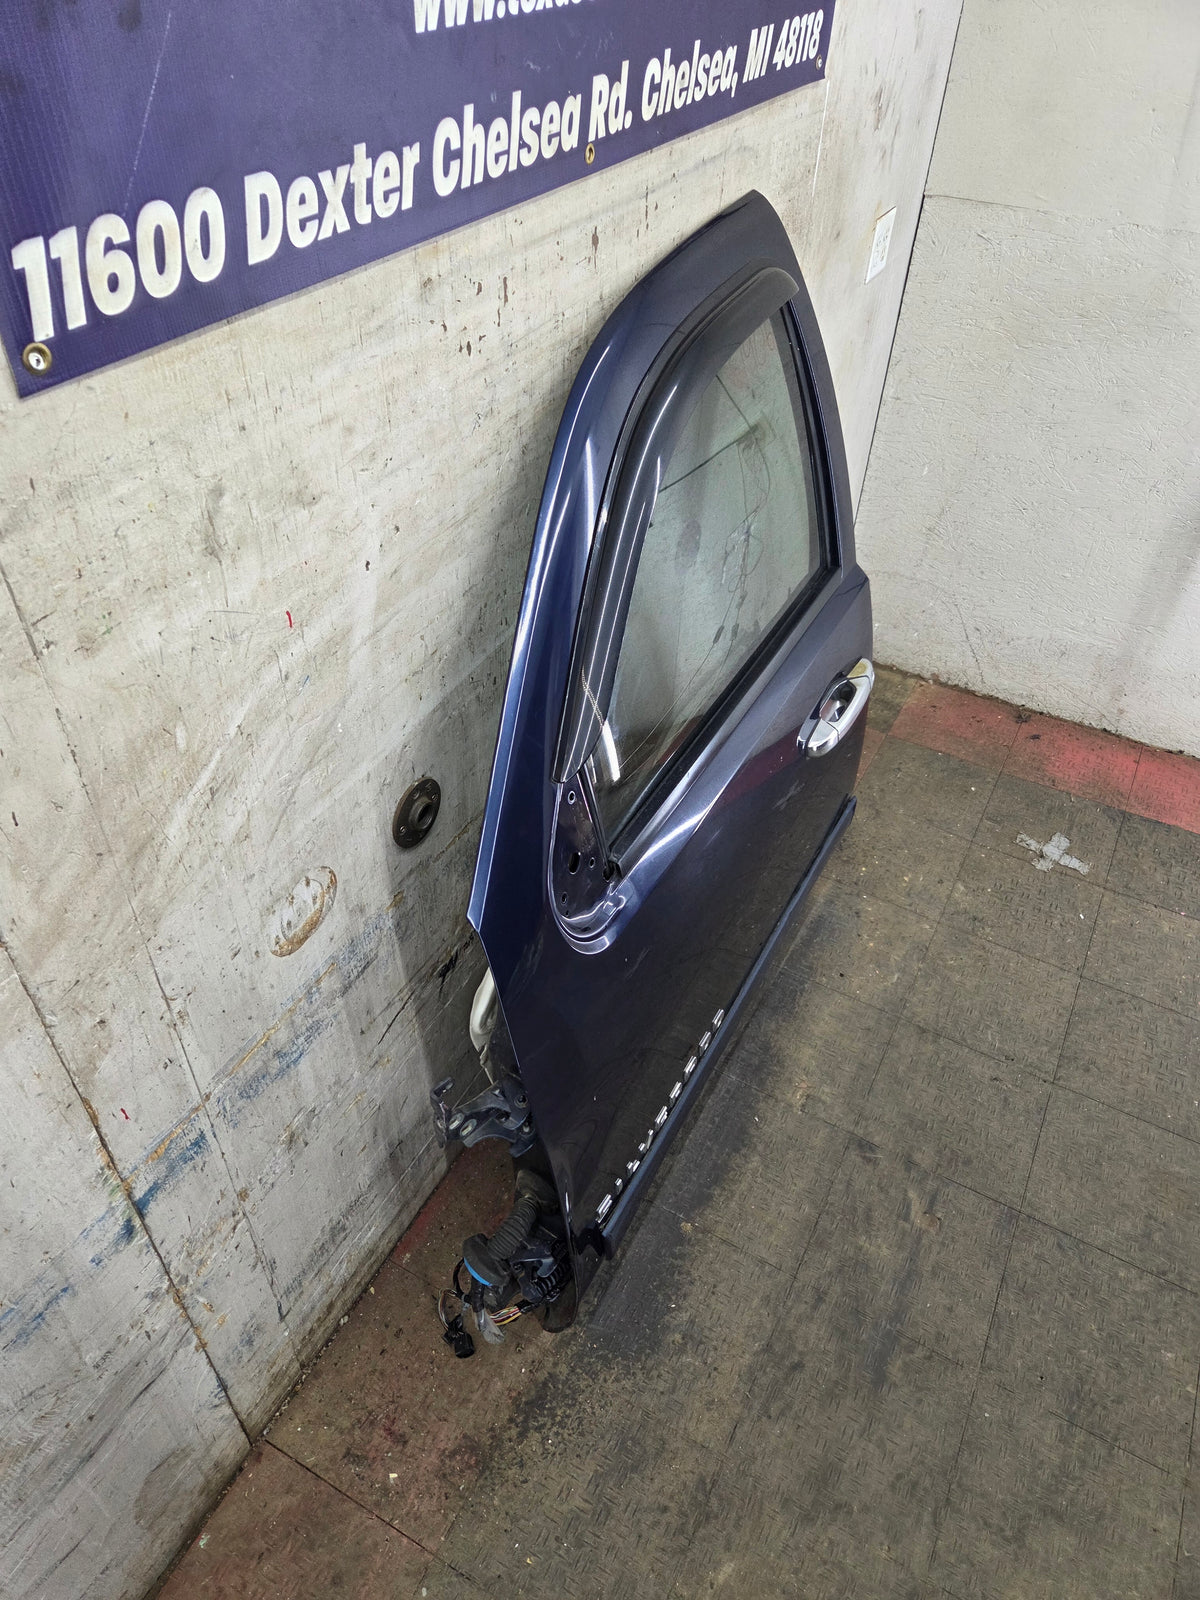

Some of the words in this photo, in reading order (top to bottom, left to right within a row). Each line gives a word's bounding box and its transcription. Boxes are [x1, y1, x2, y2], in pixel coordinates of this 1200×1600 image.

[11, 186, 226, 343] 11600
[243, 141, 421, 266] Dexter
[432, 89, 582, 197] Chelsea
[587, 59, 633, 143] Rd.
[641, 39, 739, 122] Chelsea,
[742, 23, 775, 84] MI
[772, 8, 824, 71] 48118
